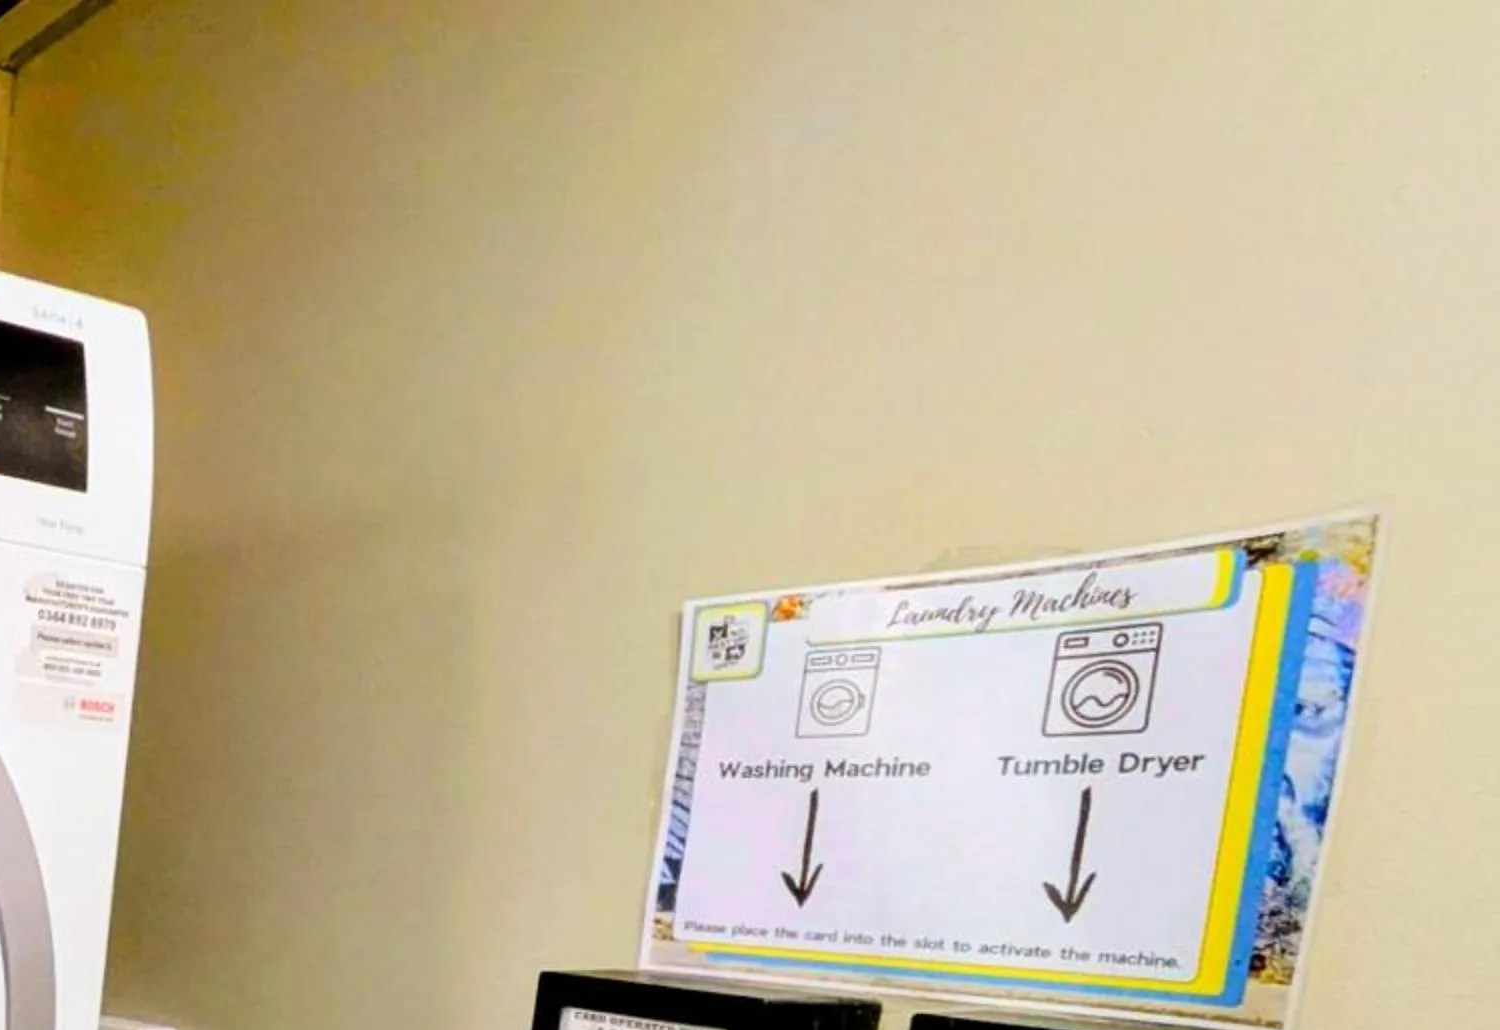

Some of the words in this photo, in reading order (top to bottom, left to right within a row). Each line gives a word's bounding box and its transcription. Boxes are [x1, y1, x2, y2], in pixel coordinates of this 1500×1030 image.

[887, 594, 999, 633] Laundry
[1009, 571, 1138, 620] Machines
[37, 609, 66, 625] 0344
[80, 698, 115, 714] BOSCH
[719, 758, 814, 782] Washing
[824, 756, 932, 778] Machine
[998, 753, 1105, 776] Tumble
[1118, 751, 1206, 778] Dryer
[684, 920, 726, 934] Please
[732, 923, 768, 937] place
[775, 927, 798, 940] the
[804, 929, 838, 943] card
[843, 933, 874, 946] into
[880, 933, 907, 948] the
[914, 936, 945, 951] slot
[953, 939, 972, 953] to
[978, 942, 1051, 960] activate
[1060, 946, 1091, 963] the
[1098, 951, 1182, 970] machine.
[573, 1011, 607, 1024] CARD
